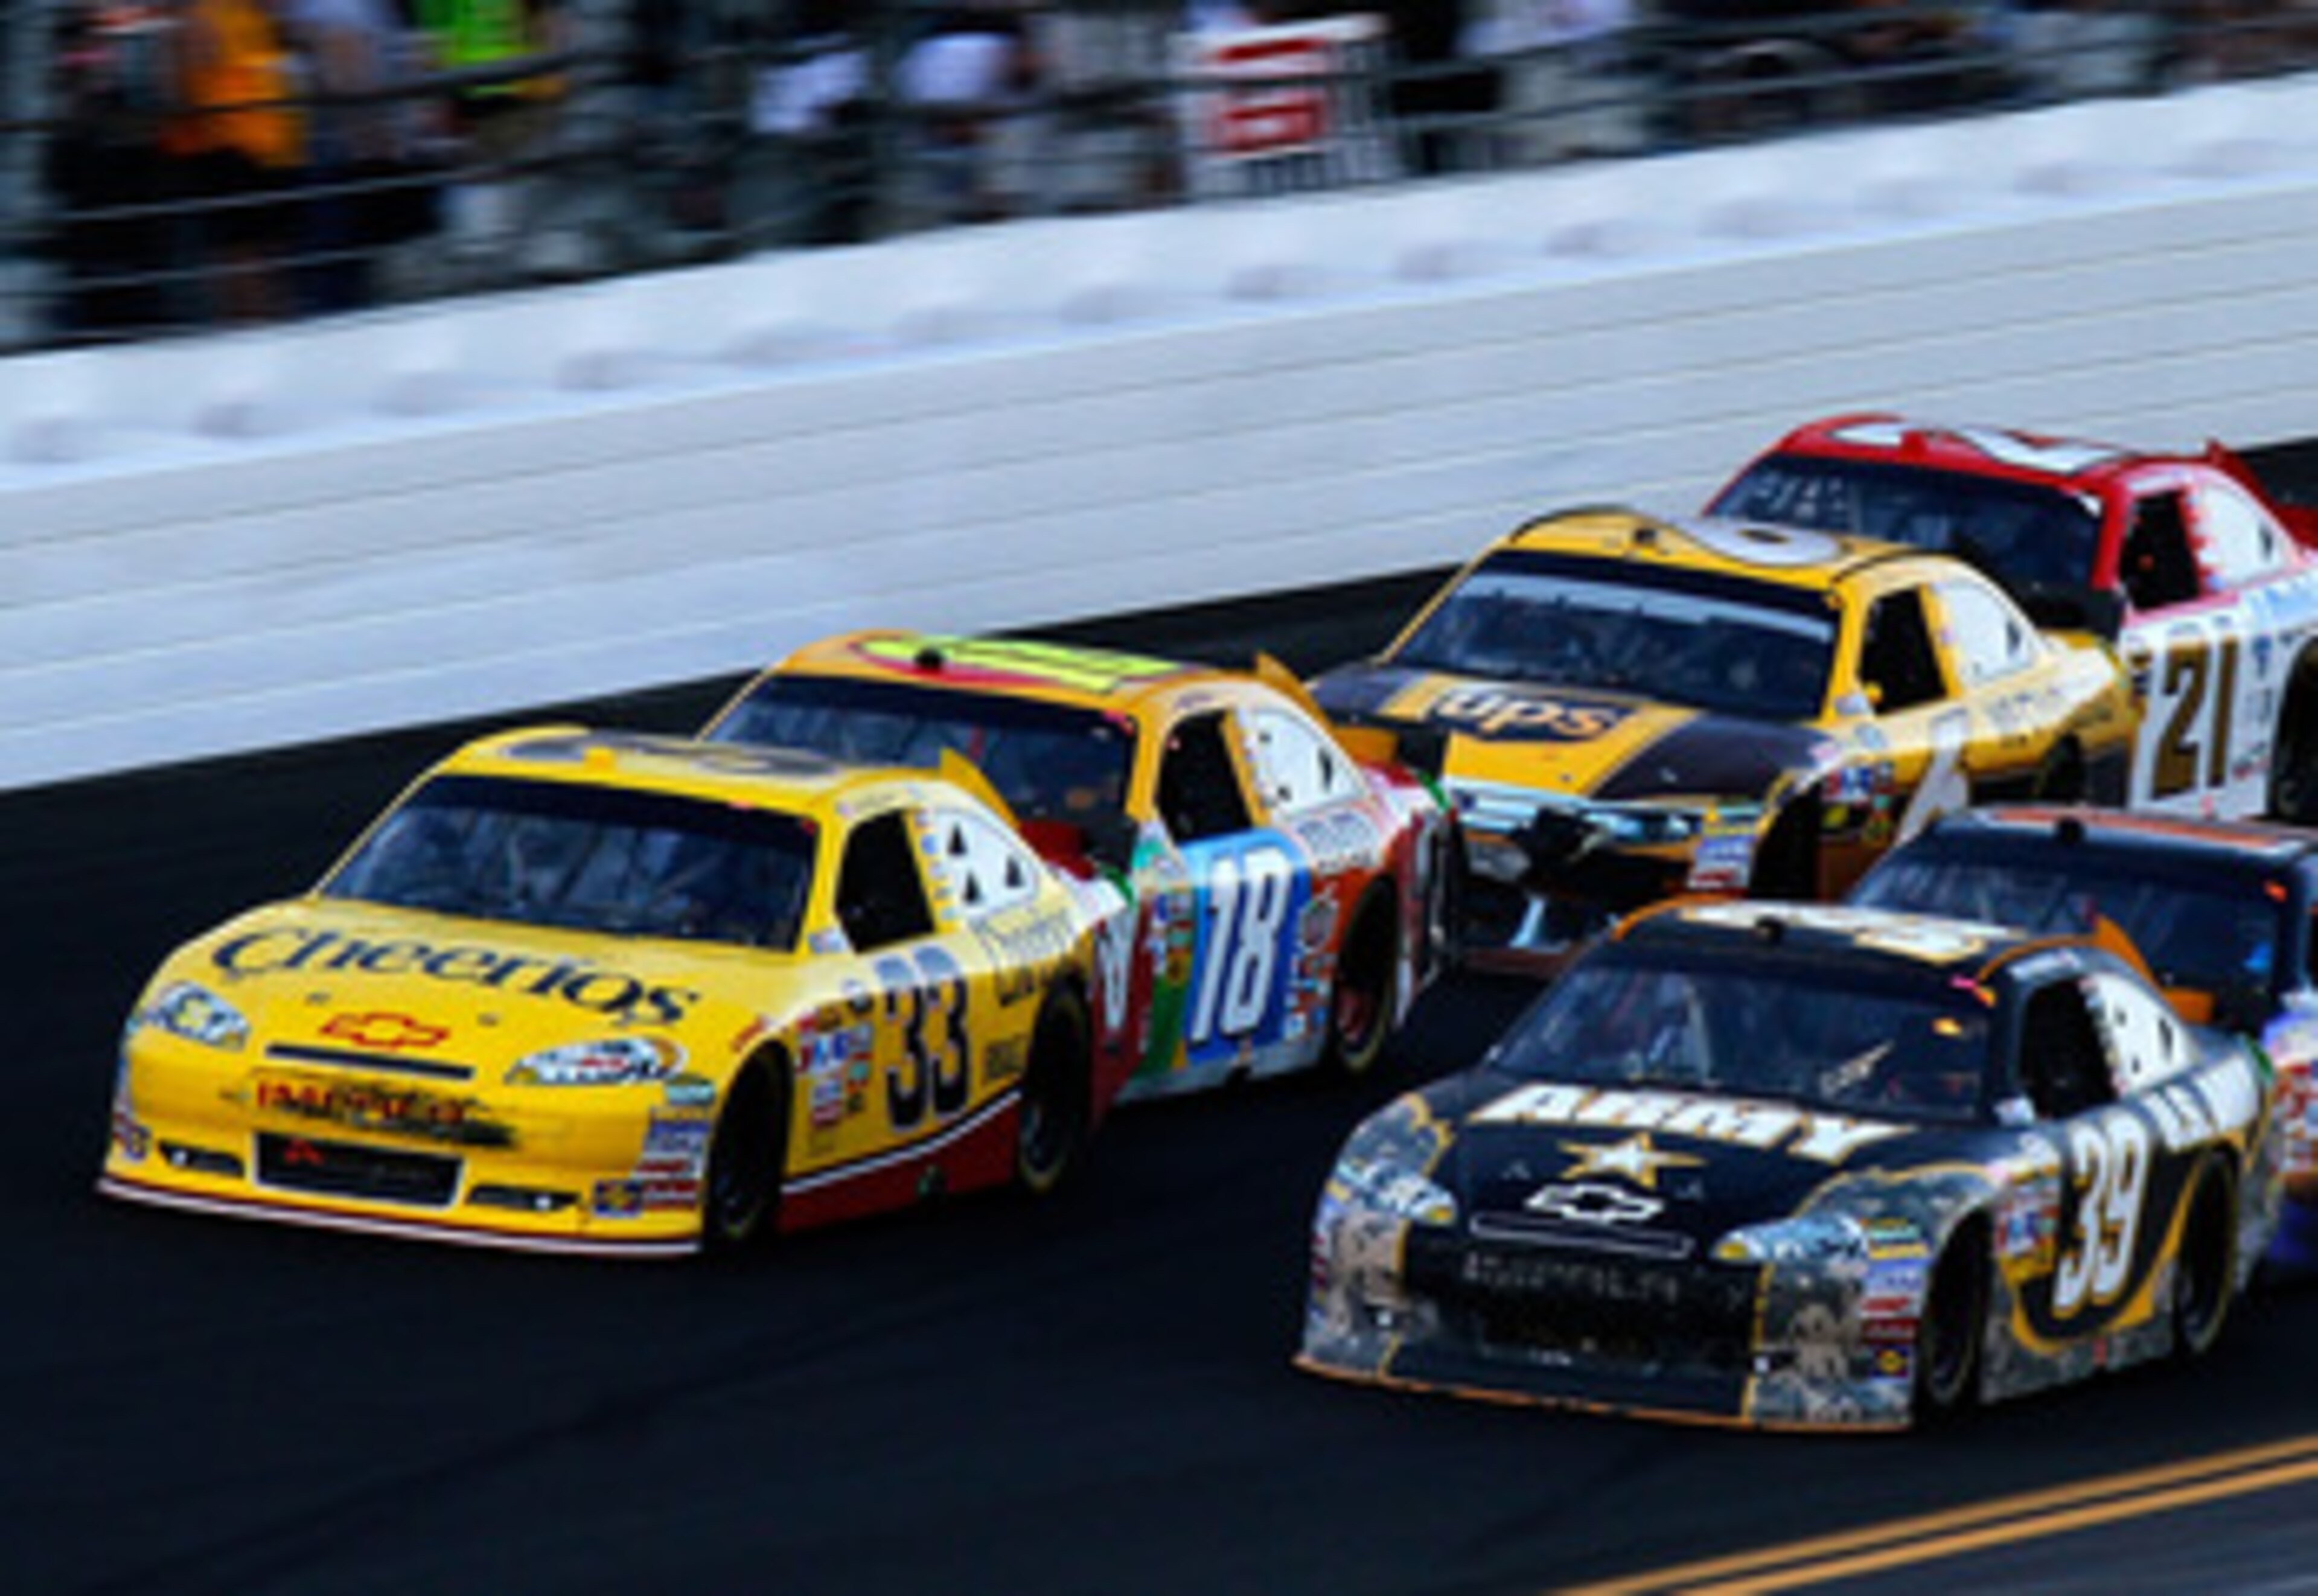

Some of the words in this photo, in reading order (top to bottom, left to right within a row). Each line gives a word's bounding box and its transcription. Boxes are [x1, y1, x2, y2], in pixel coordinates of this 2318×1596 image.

[1438, 689, 1617, 738] ups
[2150, 636, 2239, 800] 21
[212, 927, 700, 1027] Cheerios
[1192, 846, 1292, 1044] 18
[874, 946, 969, 1131] 33
[1467, 1082, 1920, 1163] ARMY
[2052, 1111, 2149, 1319] 39
